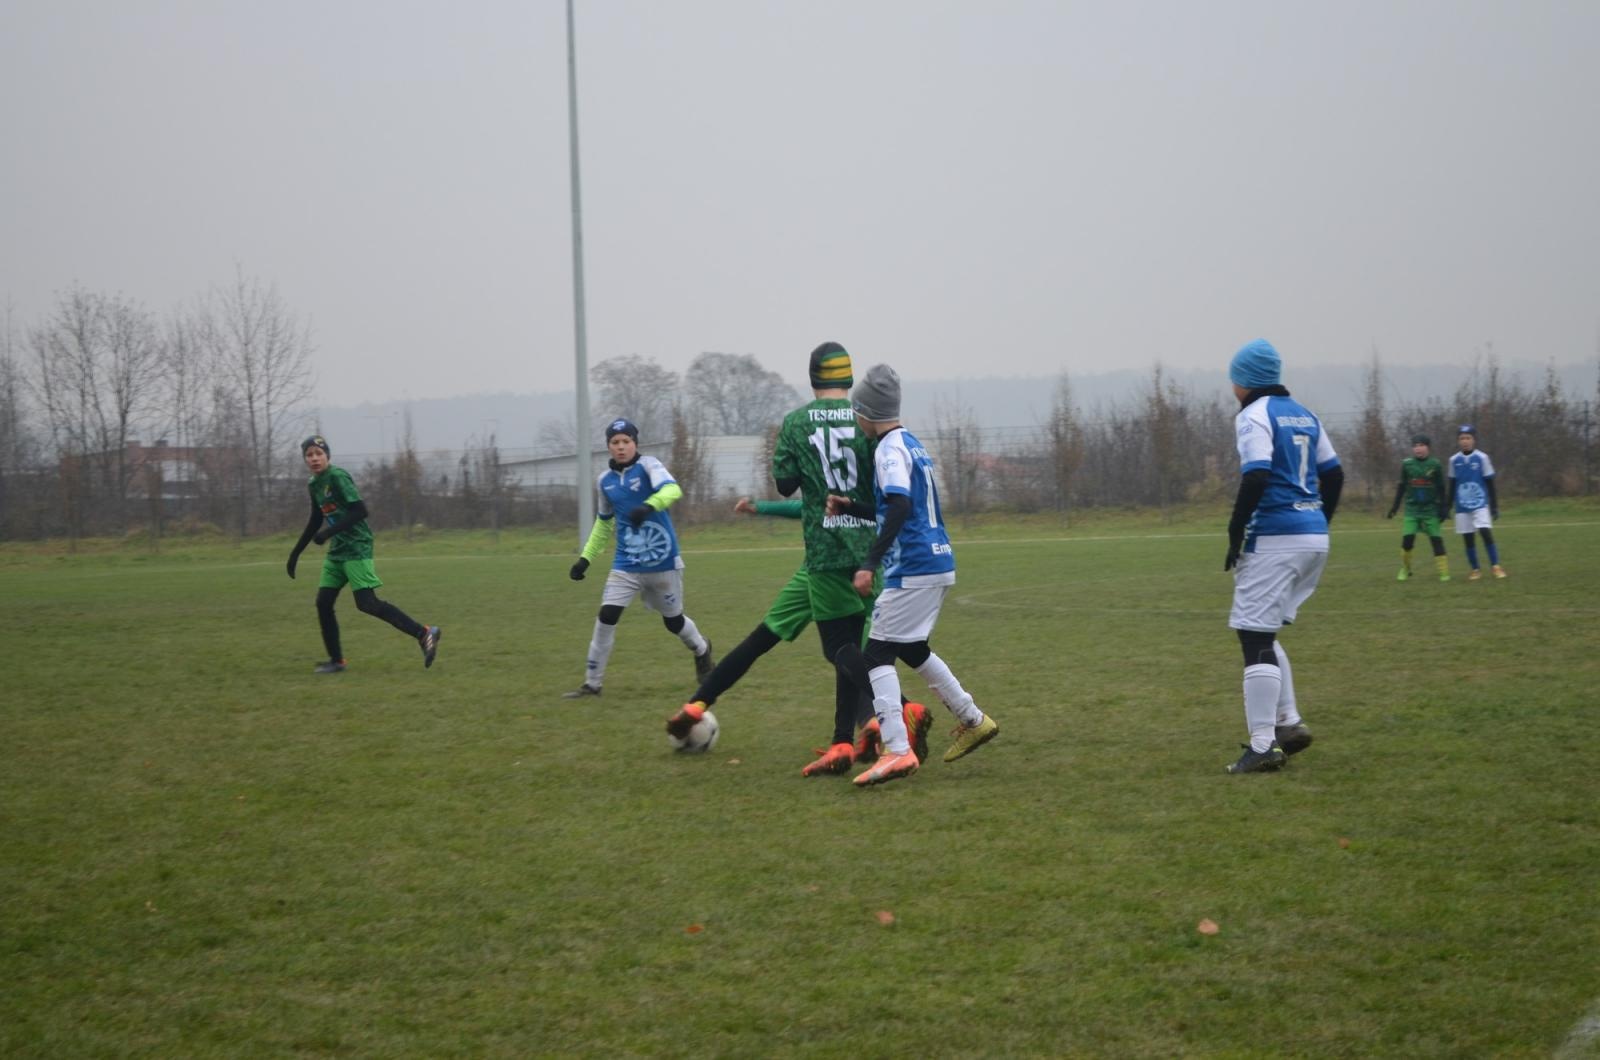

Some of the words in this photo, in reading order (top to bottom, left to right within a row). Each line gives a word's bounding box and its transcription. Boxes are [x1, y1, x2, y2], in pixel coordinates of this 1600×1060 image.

[808, 408, 854, 421] TESZNER
[808, 426, 857, 492] 15
[1292, 434, 1312, 494] 7
